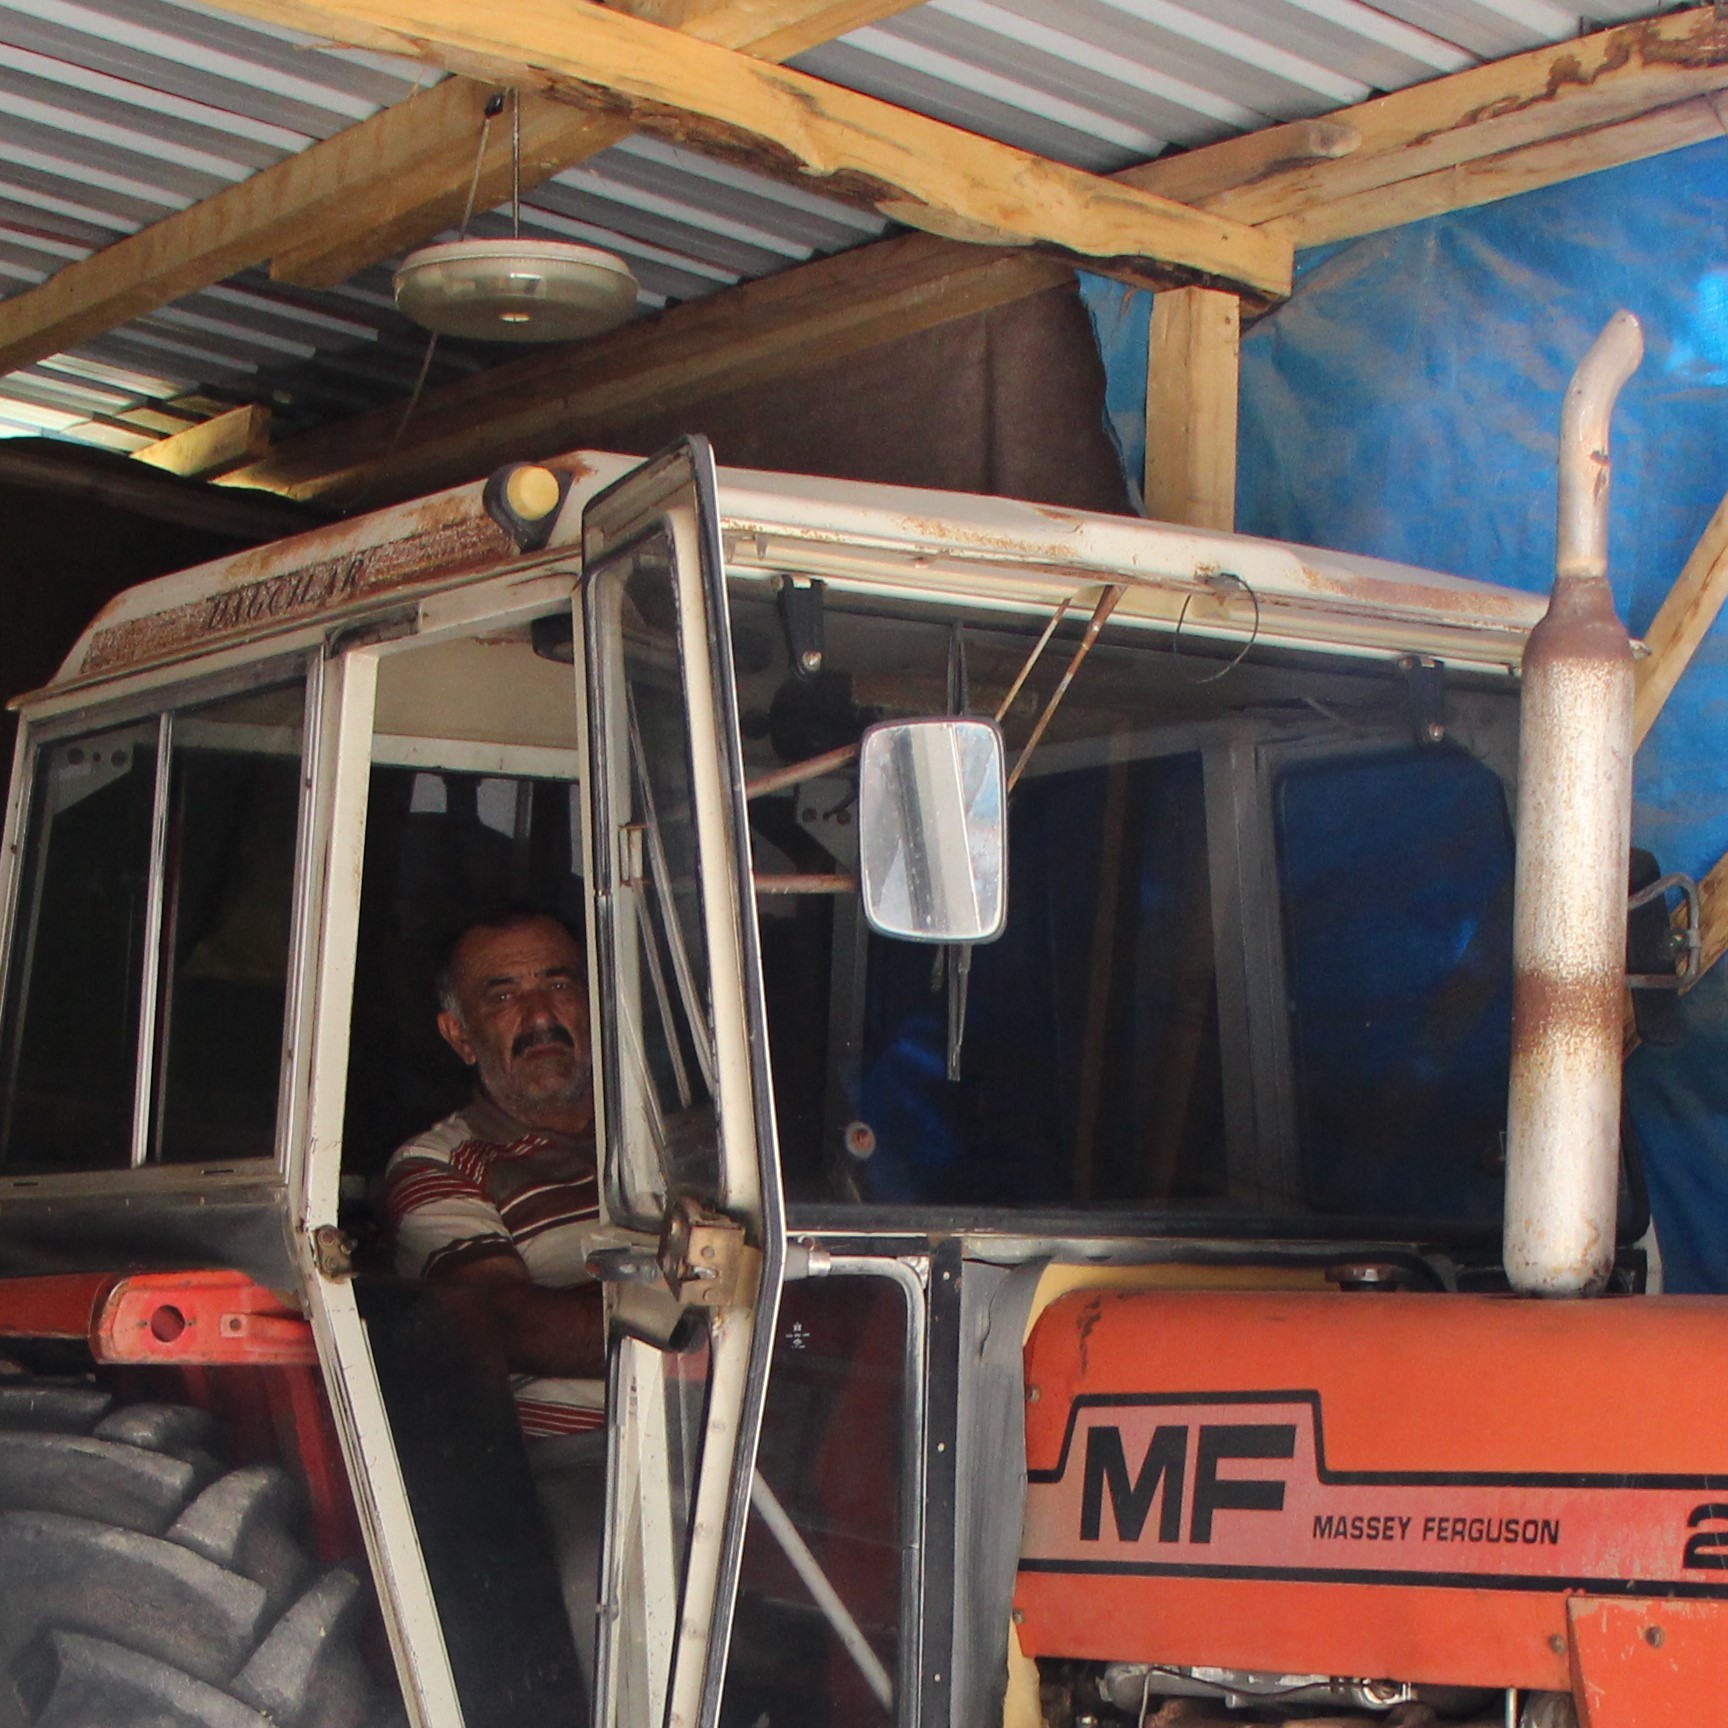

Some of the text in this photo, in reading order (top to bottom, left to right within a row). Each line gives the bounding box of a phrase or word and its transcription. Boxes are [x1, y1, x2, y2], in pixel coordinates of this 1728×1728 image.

[1079, 1423, 1297, 1544] MF
[1312, 1514, 1561, 1546] MASSEY FERGUSON
